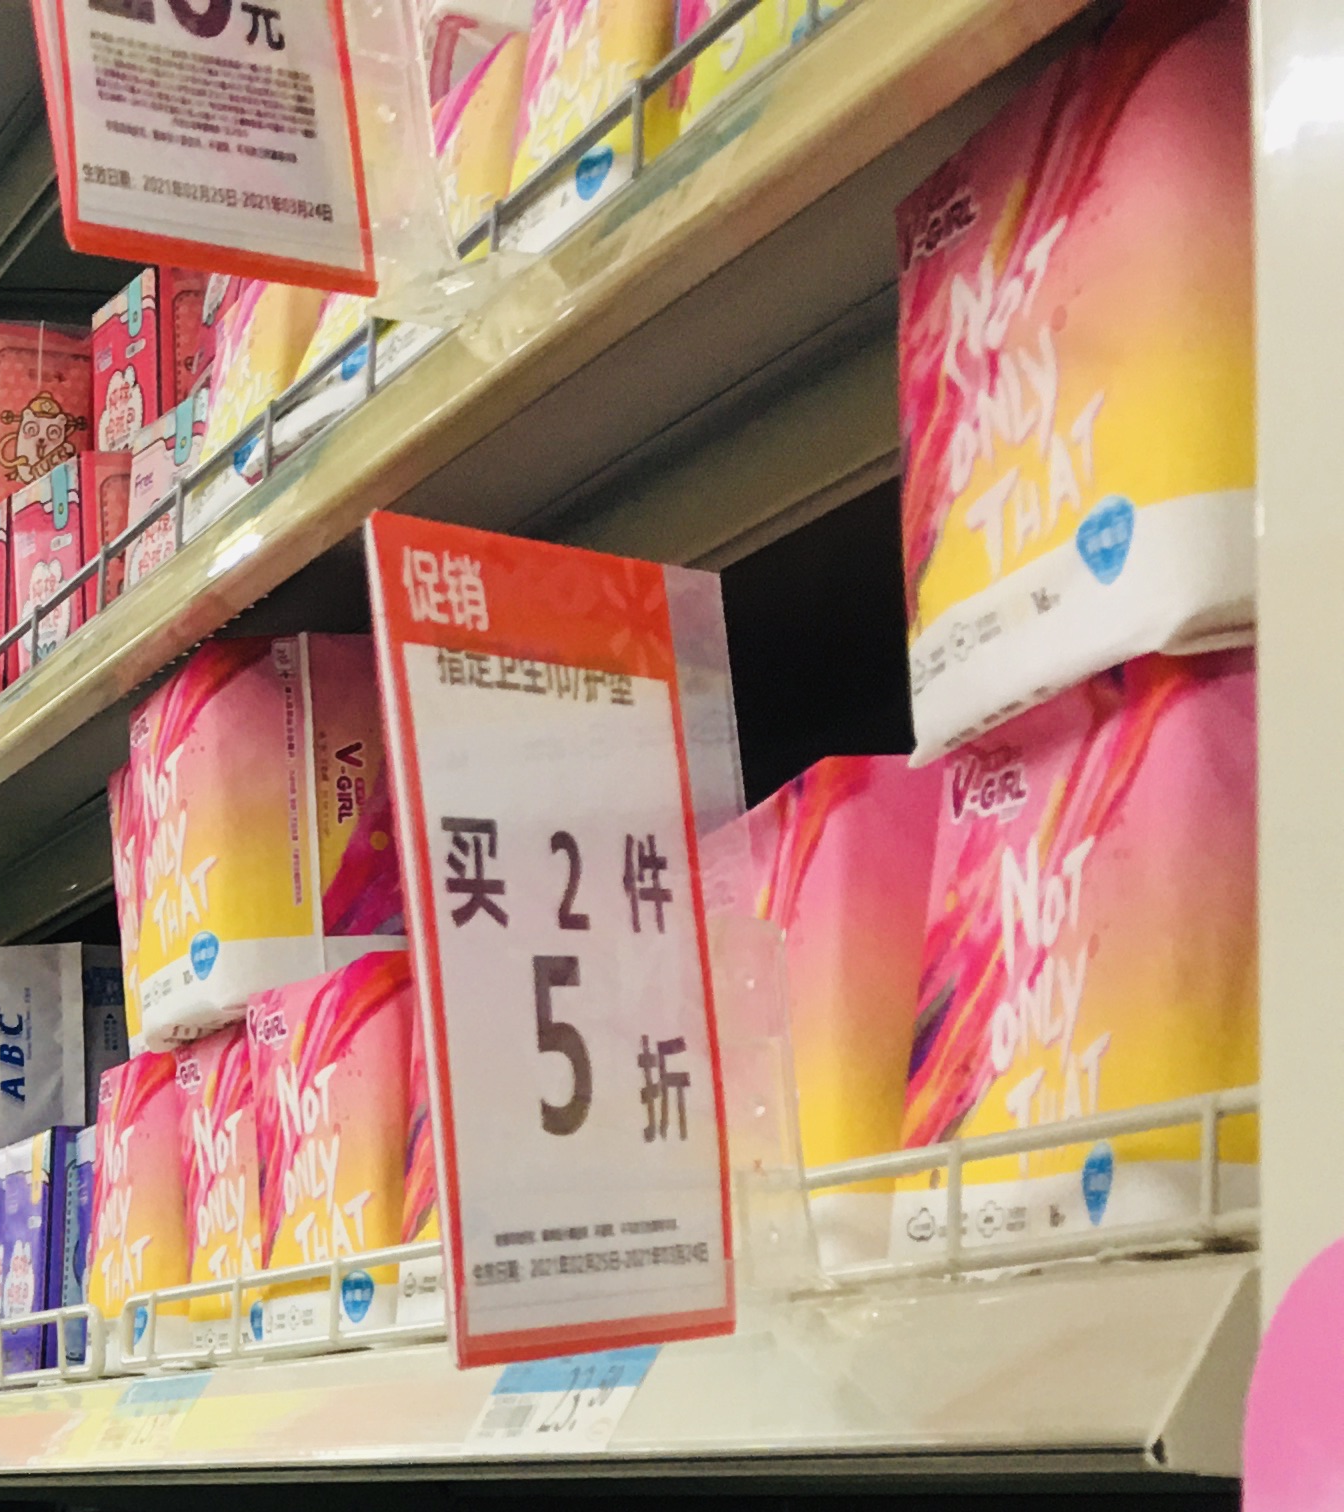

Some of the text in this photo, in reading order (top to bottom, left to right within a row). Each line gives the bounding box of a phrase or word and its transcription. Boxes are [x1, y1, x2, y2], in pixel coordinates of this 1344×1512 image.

[402, 544, 490, 633] 促销
[334, 741, 364, 825] V-GIRL
[152, 854, 218, 955] THAT
[440, 815, 675, 936] 买 2 件
[531, 954, 692, 1143] 5 折
[192, 1106, 244, 1188] NOT
[275, 1061, 338, 1155] NOT
